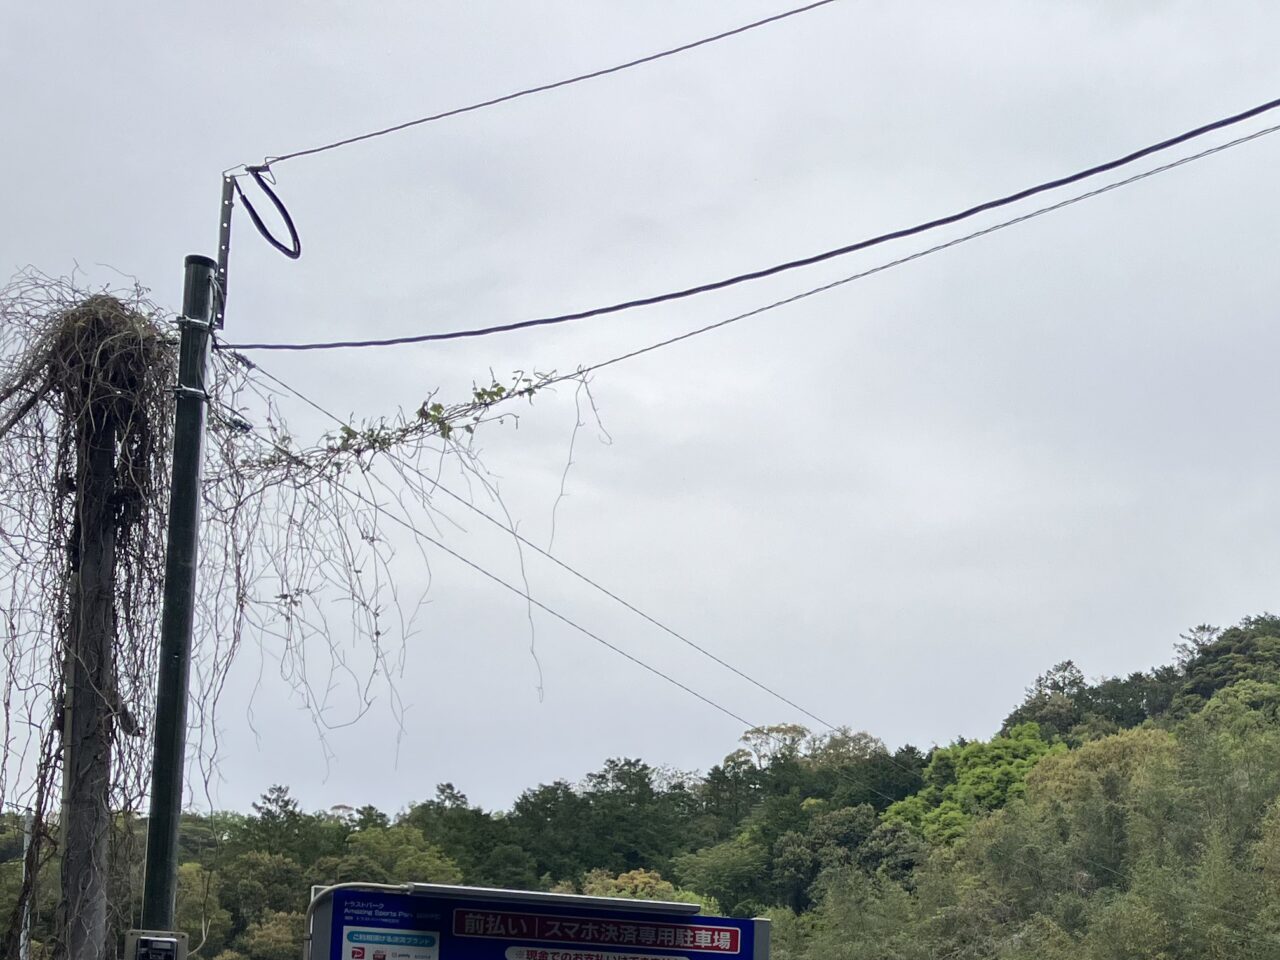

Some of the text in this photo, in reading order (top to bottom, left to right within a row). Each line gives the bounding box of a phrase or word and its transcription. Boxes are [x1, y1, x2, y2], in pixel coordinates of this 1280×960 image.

[343, 907, 372, 916] Amazing
[464, 912, 732, 950] 前払い スマホ決済専用駐車場
